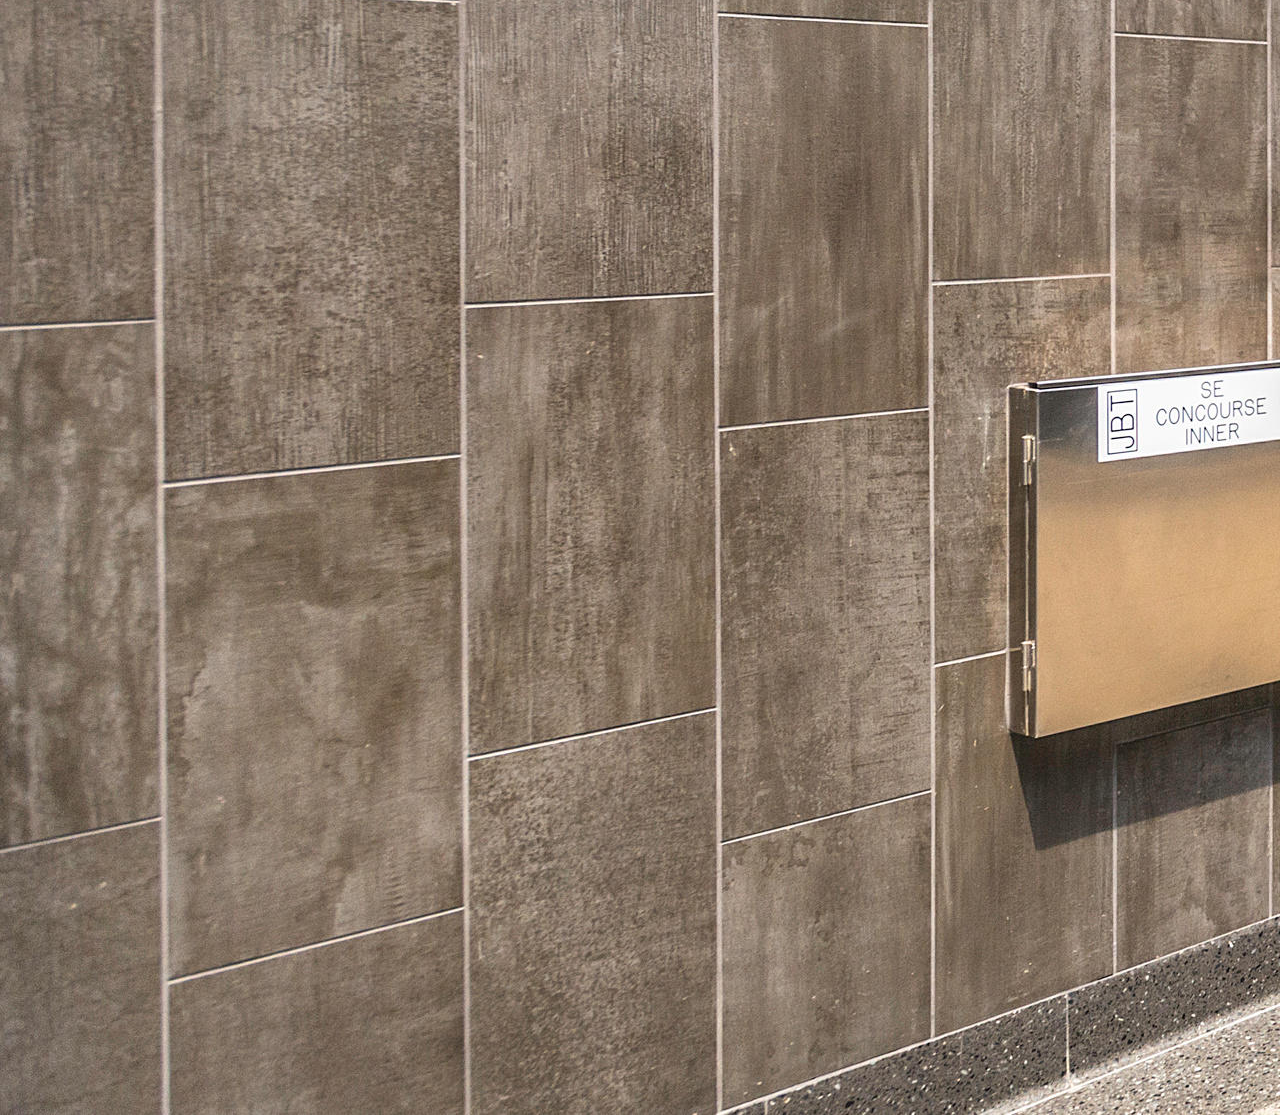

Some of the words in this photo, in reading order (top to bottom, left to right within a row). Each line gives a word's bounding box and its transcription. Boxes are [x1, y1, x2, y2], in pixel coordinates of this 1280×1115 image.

[1200, 380, 1224, 399] SE
[1110, 395, 1135, 449] JBT
[1156, 397, 1267, 426] CONCOURSE
[1185, 422, 1240, 445] INNER
